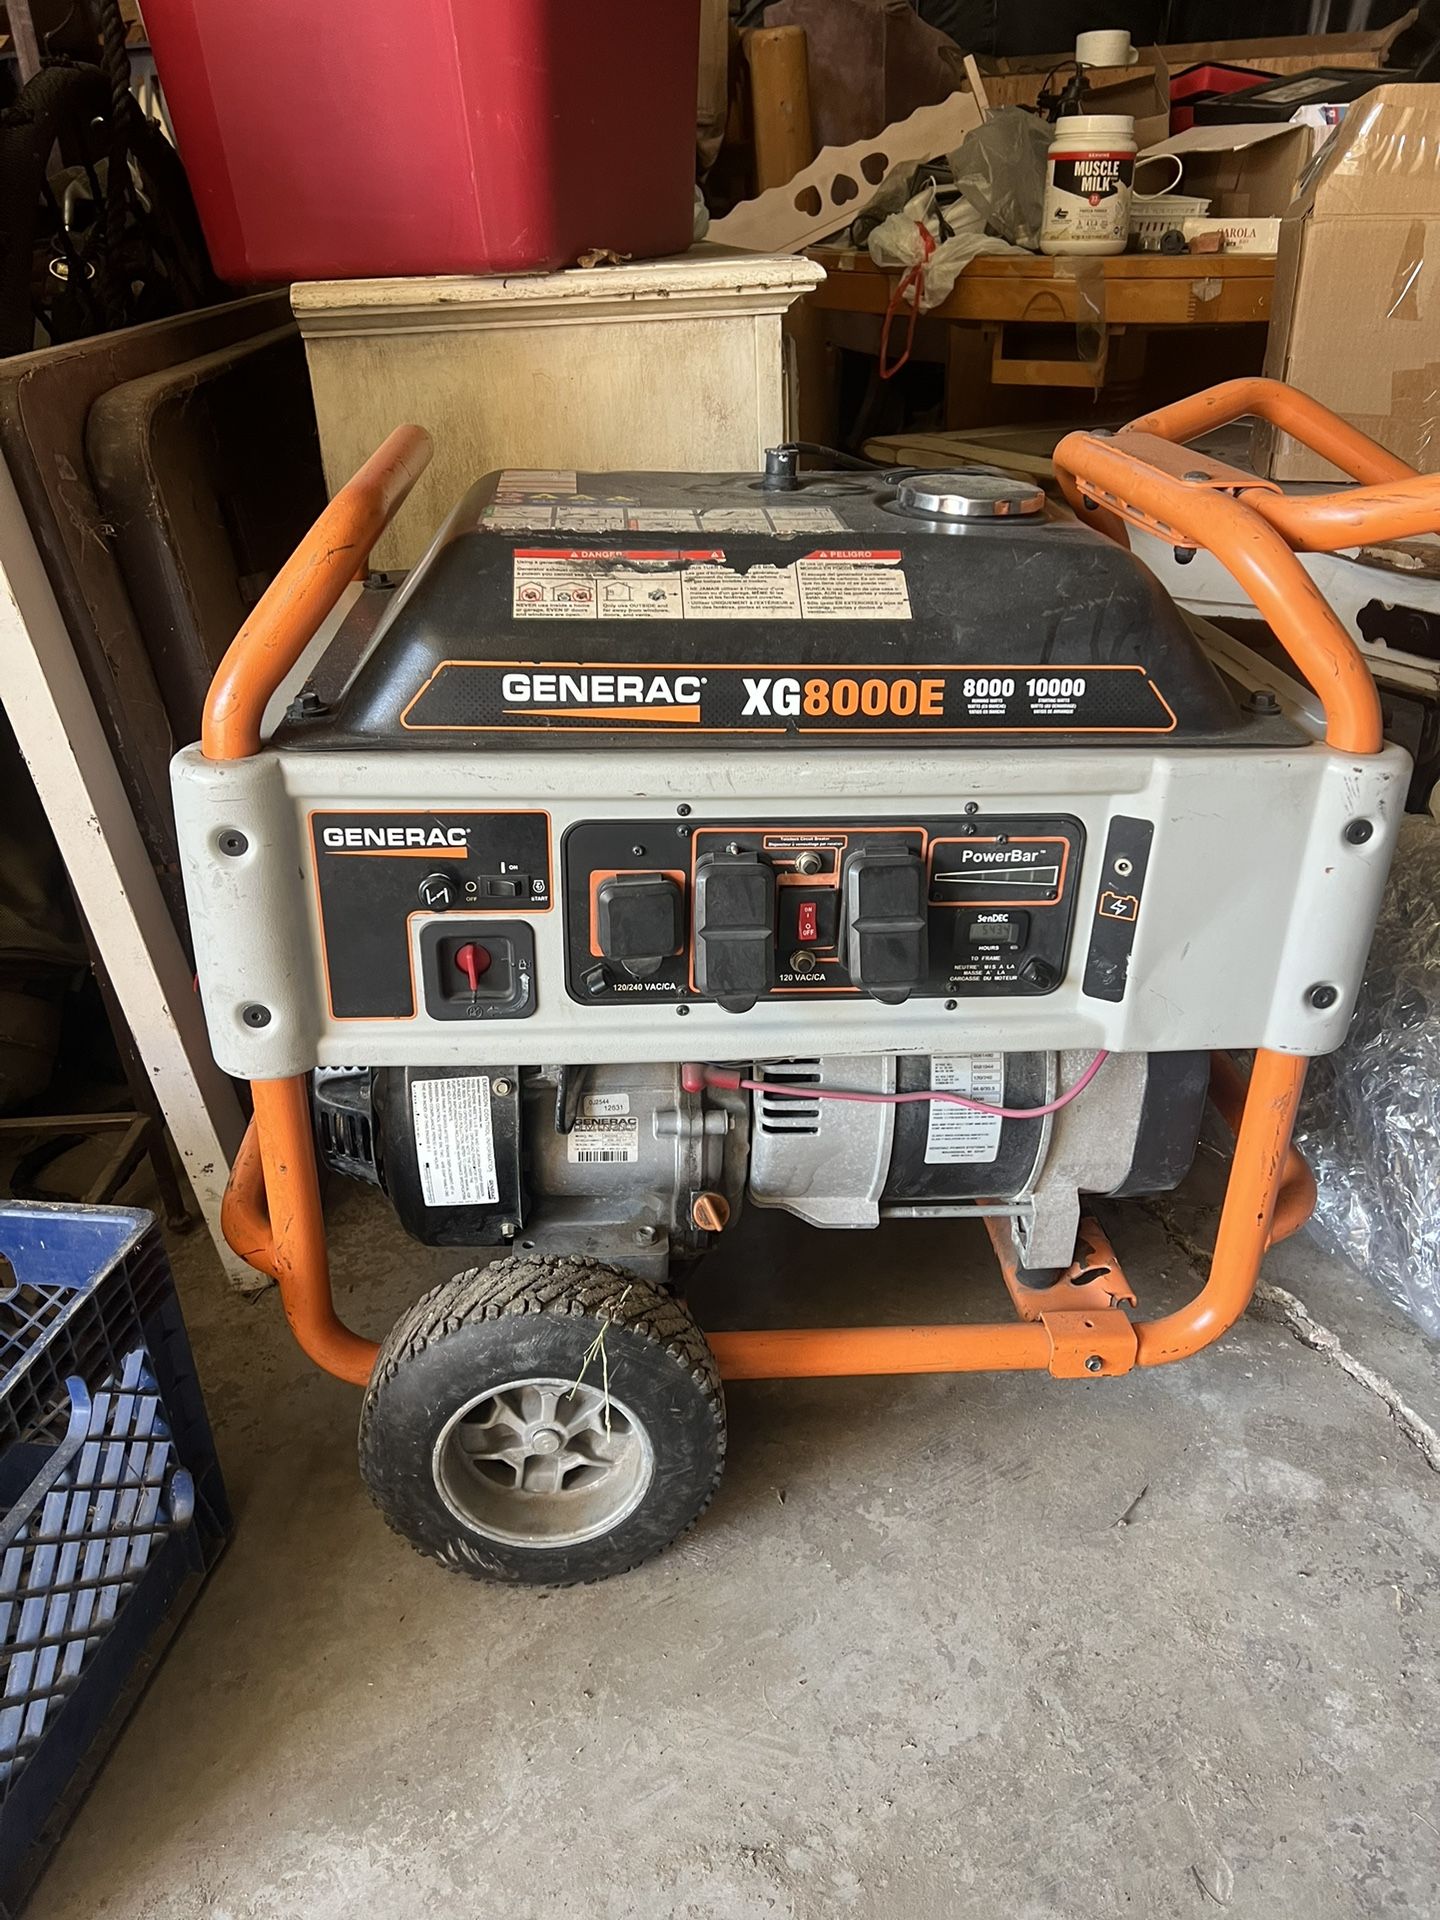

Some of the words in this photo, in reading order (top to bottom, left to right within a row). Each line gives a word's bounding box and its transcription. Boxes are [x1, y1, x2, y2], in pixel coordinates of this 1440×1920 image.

[1074, 160, 1120, 176] MUSCLE
[1081, 176, 1110, 192] MILK
[502, 673, 701, 703] GENERAC
[962, 678, 1015, 698] 8000
[1026, 678, 1086, 698] 10000
[741, 678, 946, 717] XG8000E
[323, 828, 468, 846] GENERAC
[977, 914, 1009, 922] SenDEC
